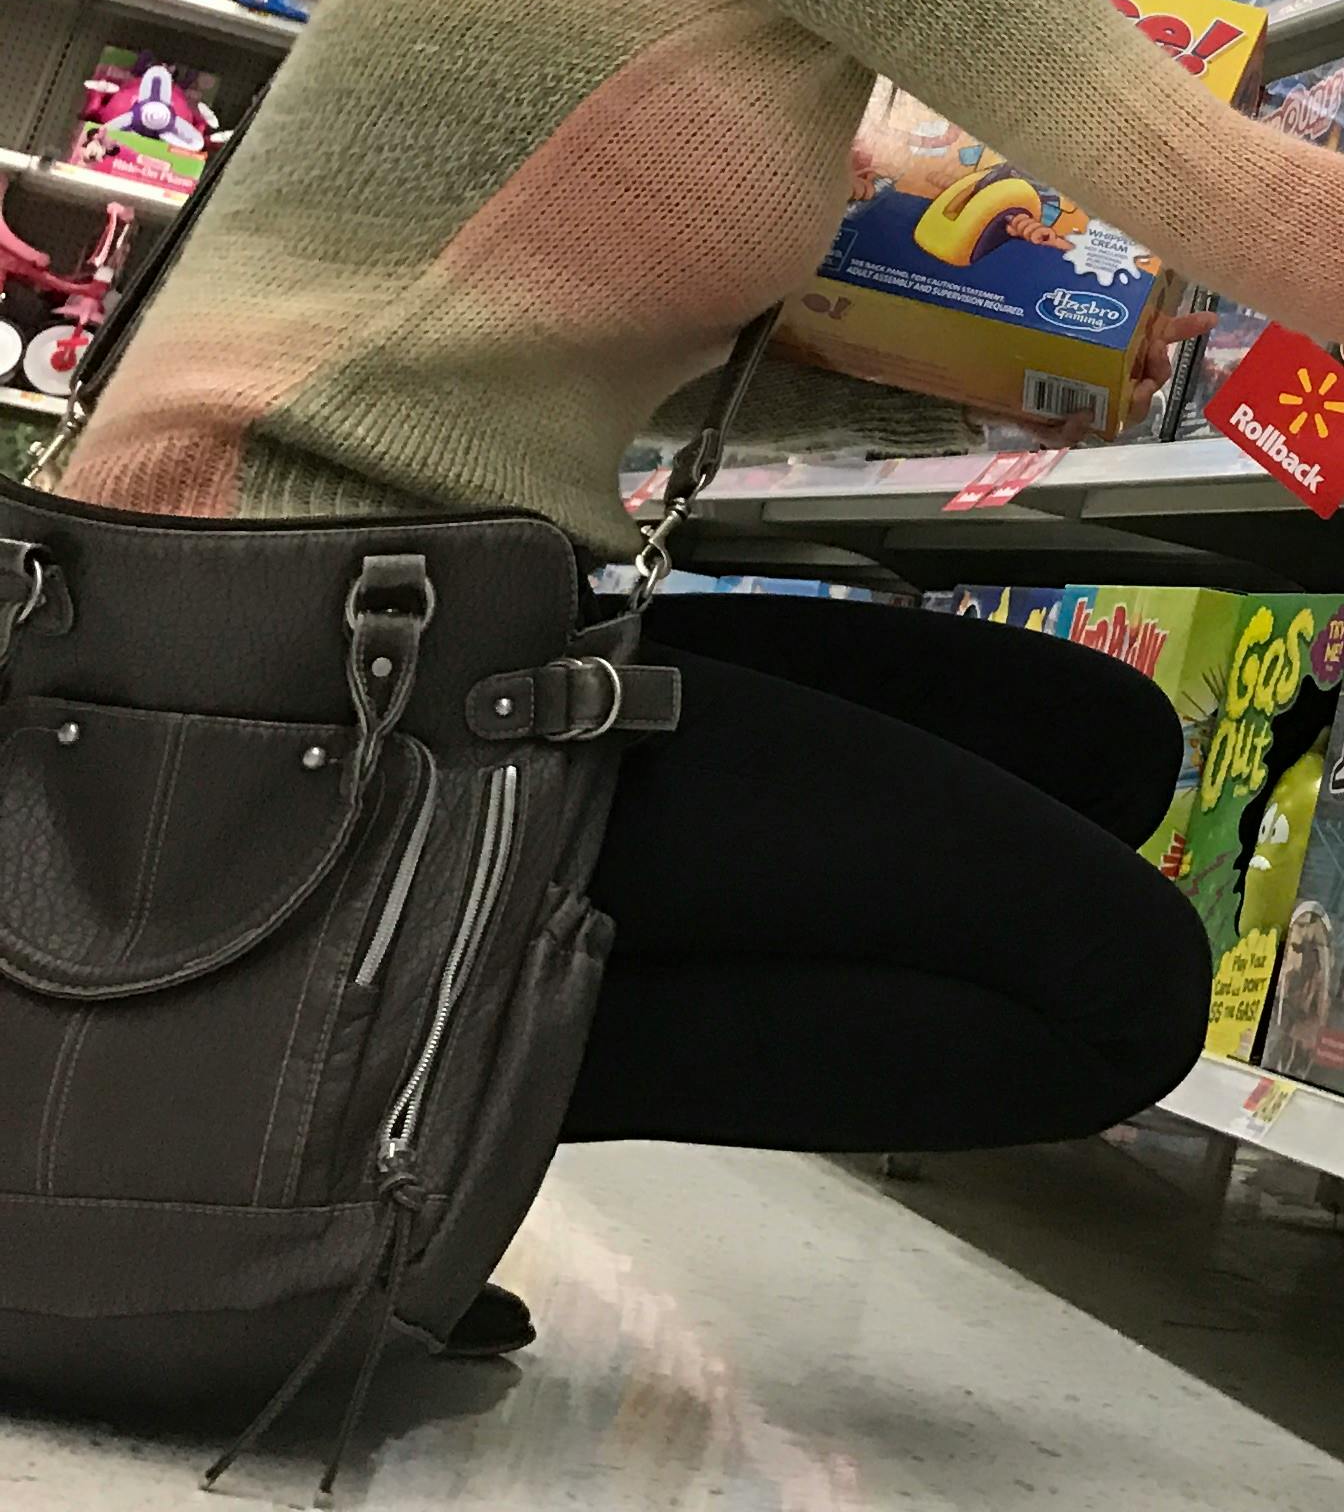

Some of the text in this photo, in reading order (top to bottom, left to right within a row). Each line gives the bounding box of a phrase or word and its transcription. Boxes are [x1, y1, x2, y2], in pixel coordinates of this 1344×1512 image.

[1090, 238, 1128, 254] CREAM
[846, 266, 1025, 317] ADULT ASSEMBLY AND SUPERVISION REQUIRED.
[1050, 289, 1120, 320] Hasbro
[1055, 307, 1105, 328] Gaming
[1230, 404, 1324, 493] Rollback
[1324, 642, 1344, 663] ME!
